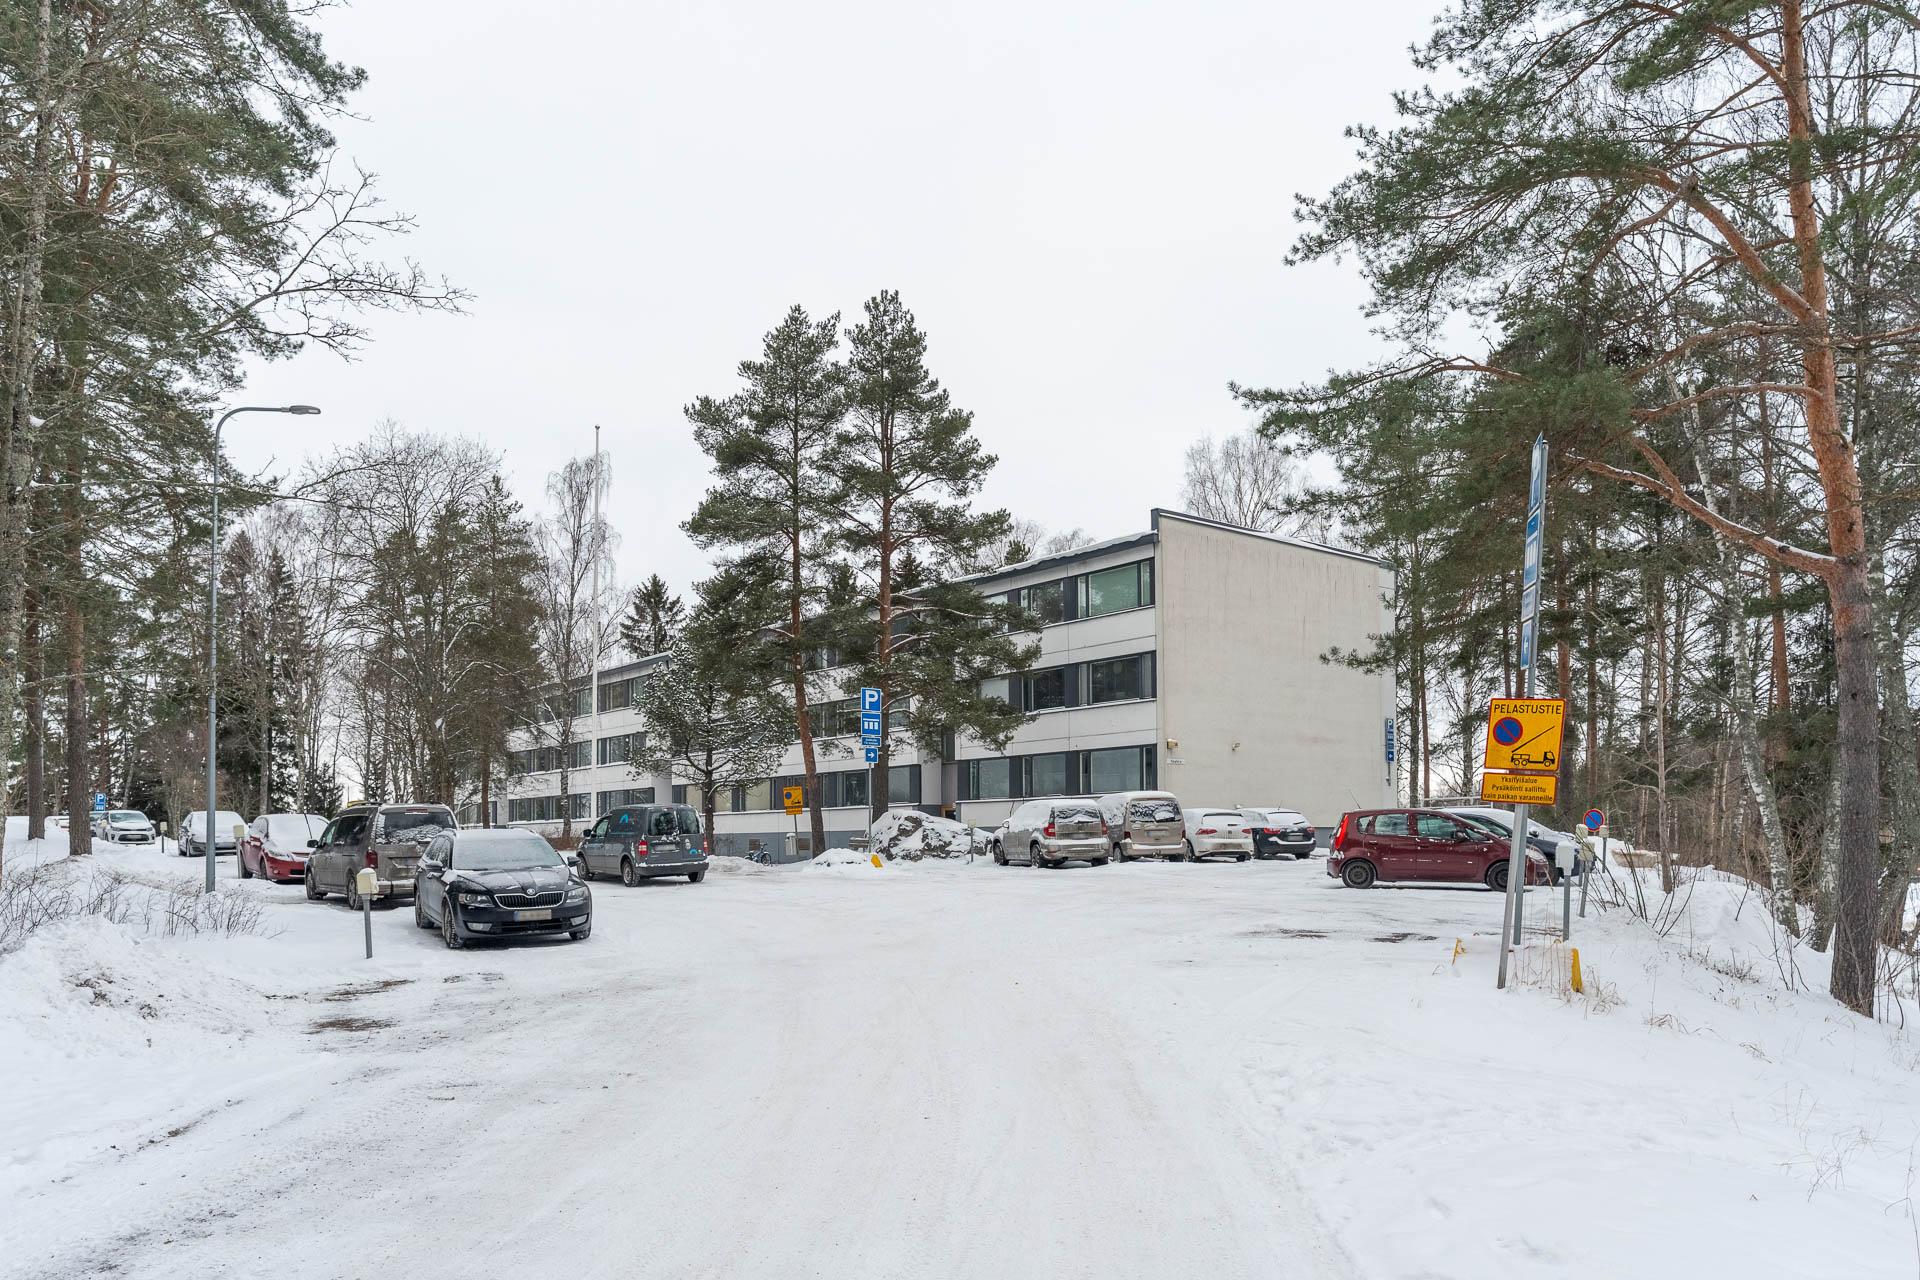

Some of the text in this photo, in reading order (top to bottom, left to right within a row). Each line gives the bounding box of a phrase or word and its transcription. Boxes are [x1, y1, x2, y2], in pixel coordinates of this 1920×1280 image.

[865, 690, 879, 710] P
[1493, 703, 1562, 715] PELASTUSTIE
[1387, 719, 1393, 729] P
[1501, 776, 1537, 784] Yksityisalue
[97, 794, 104, 802] P
